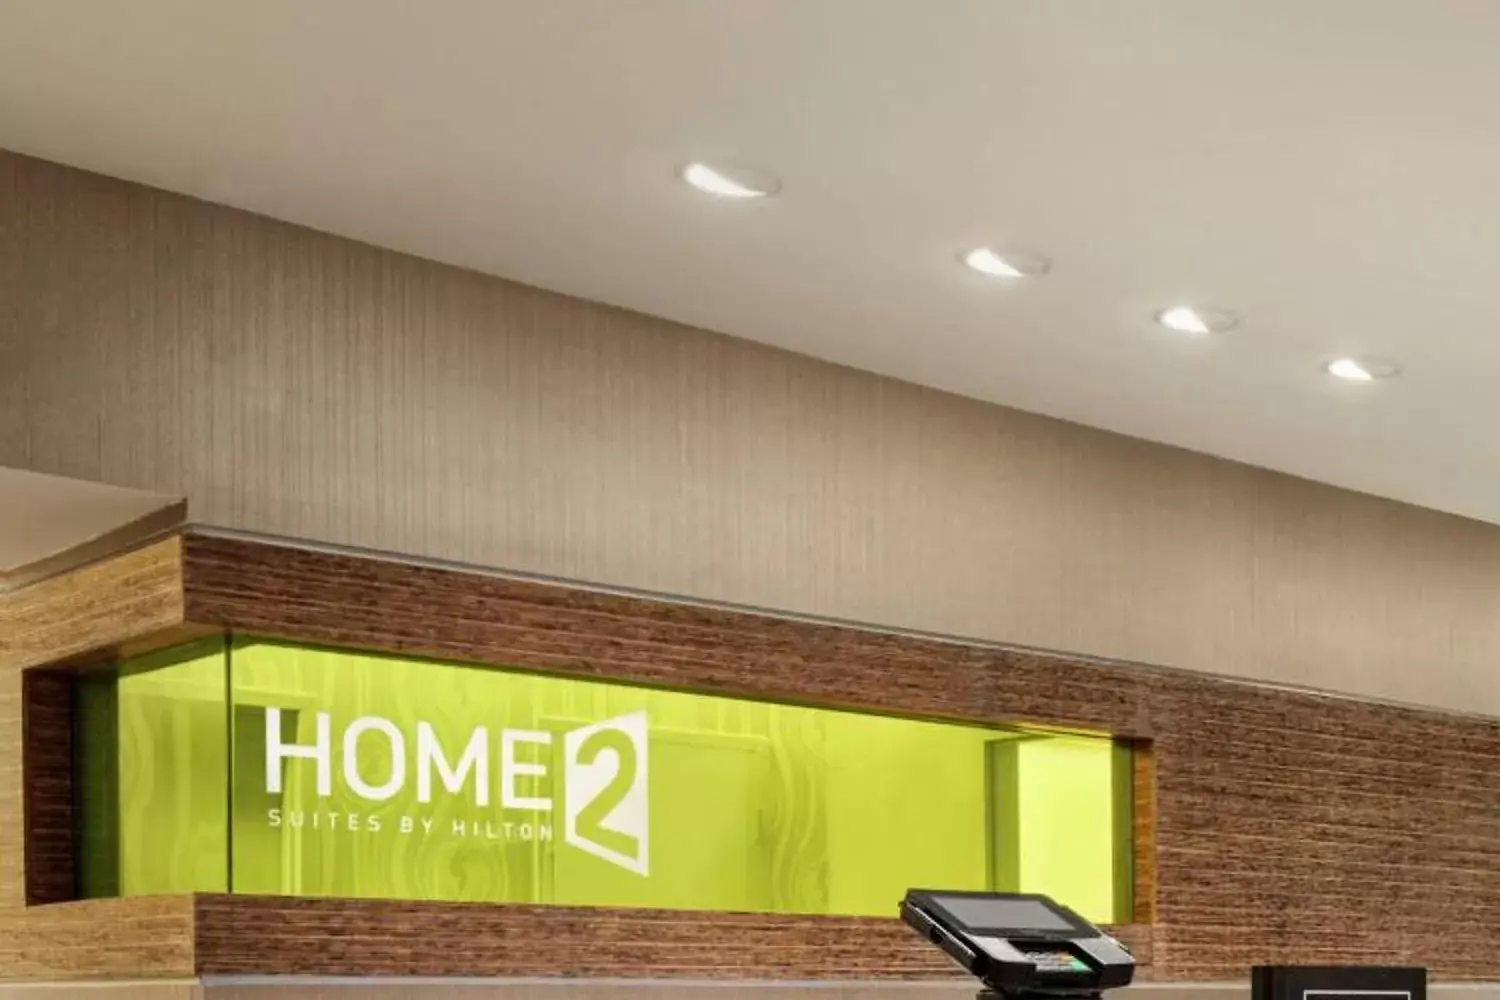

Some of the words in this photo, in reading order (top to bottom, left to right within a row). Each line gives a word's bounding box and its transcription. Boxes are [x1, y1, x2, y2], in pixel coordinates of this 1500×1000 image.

[268, 809, 382, 833] SUITES
[401, 817, 432, 834] BY
[453, 821, 552, 840] HILTON
